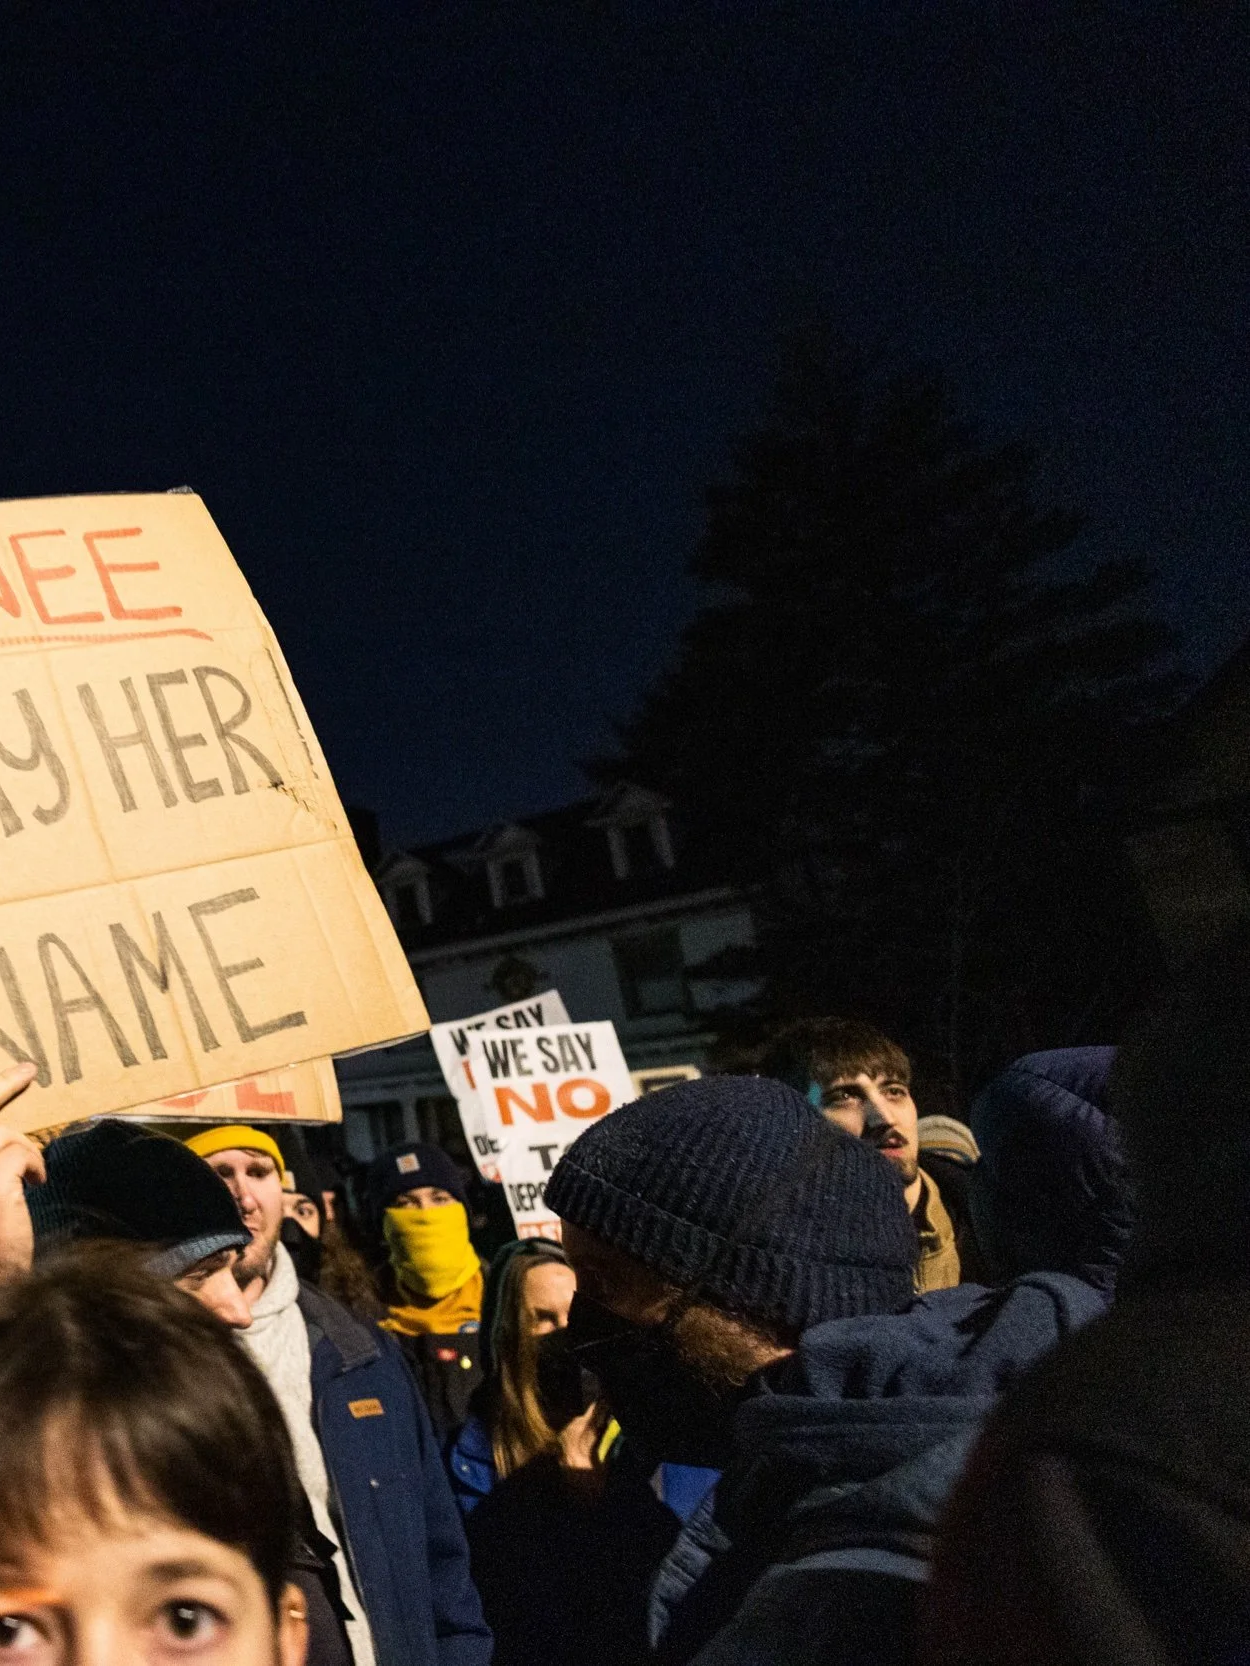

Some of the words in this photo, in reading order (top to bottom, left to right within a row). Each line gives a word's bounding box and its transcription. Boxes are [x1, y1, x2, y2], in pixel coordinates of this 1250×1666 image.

[77, 665, 286, 813] HER
[481, 1037, 534, 1080] WE
[536, 1031, 599, 1077] SAY
[493, 1077, 612, 1127] NO
[528, 1142, 573, 1171] T
